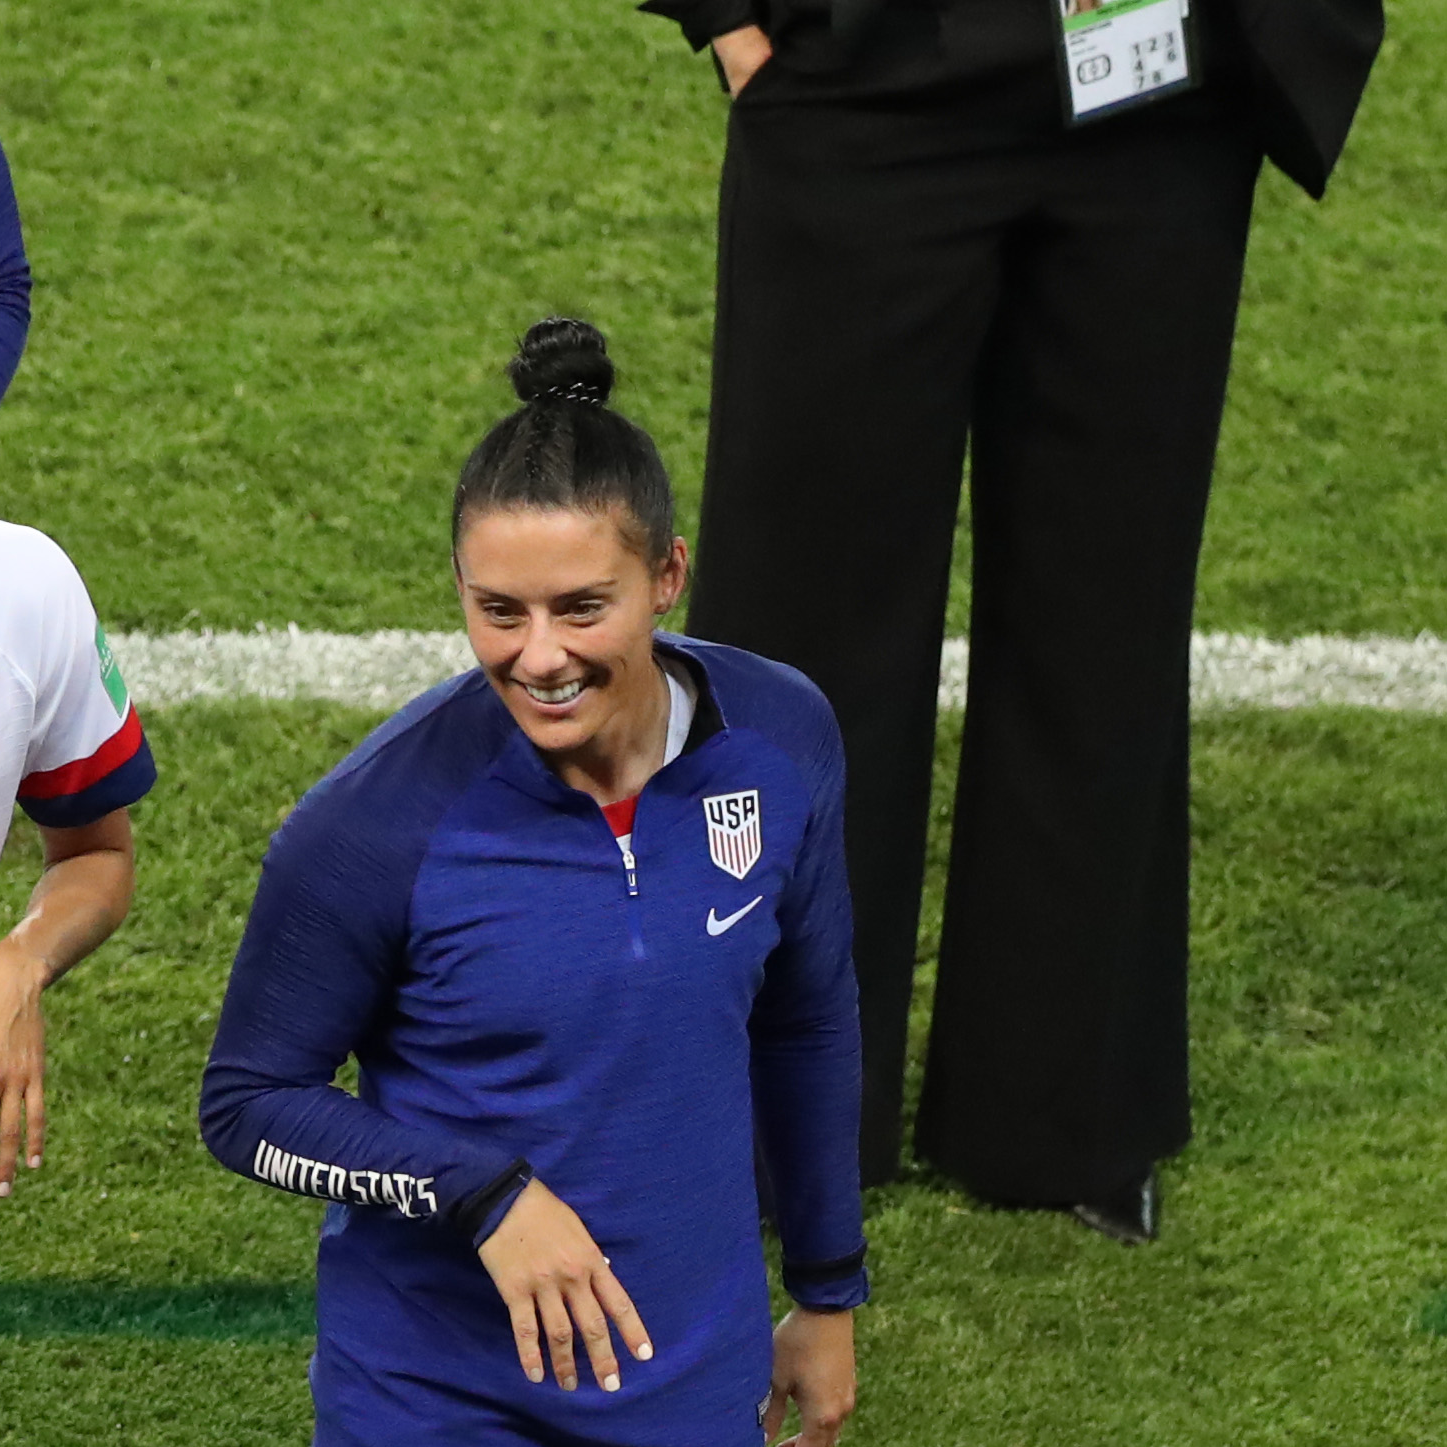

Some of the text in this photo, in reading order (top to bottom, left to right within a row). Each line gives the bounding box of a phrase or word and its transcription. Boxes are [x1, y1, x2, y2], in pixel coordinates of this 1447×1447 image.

[708, 795, 755, 830] USA
[253, 1138, 438, 1219] UNITED STATES
